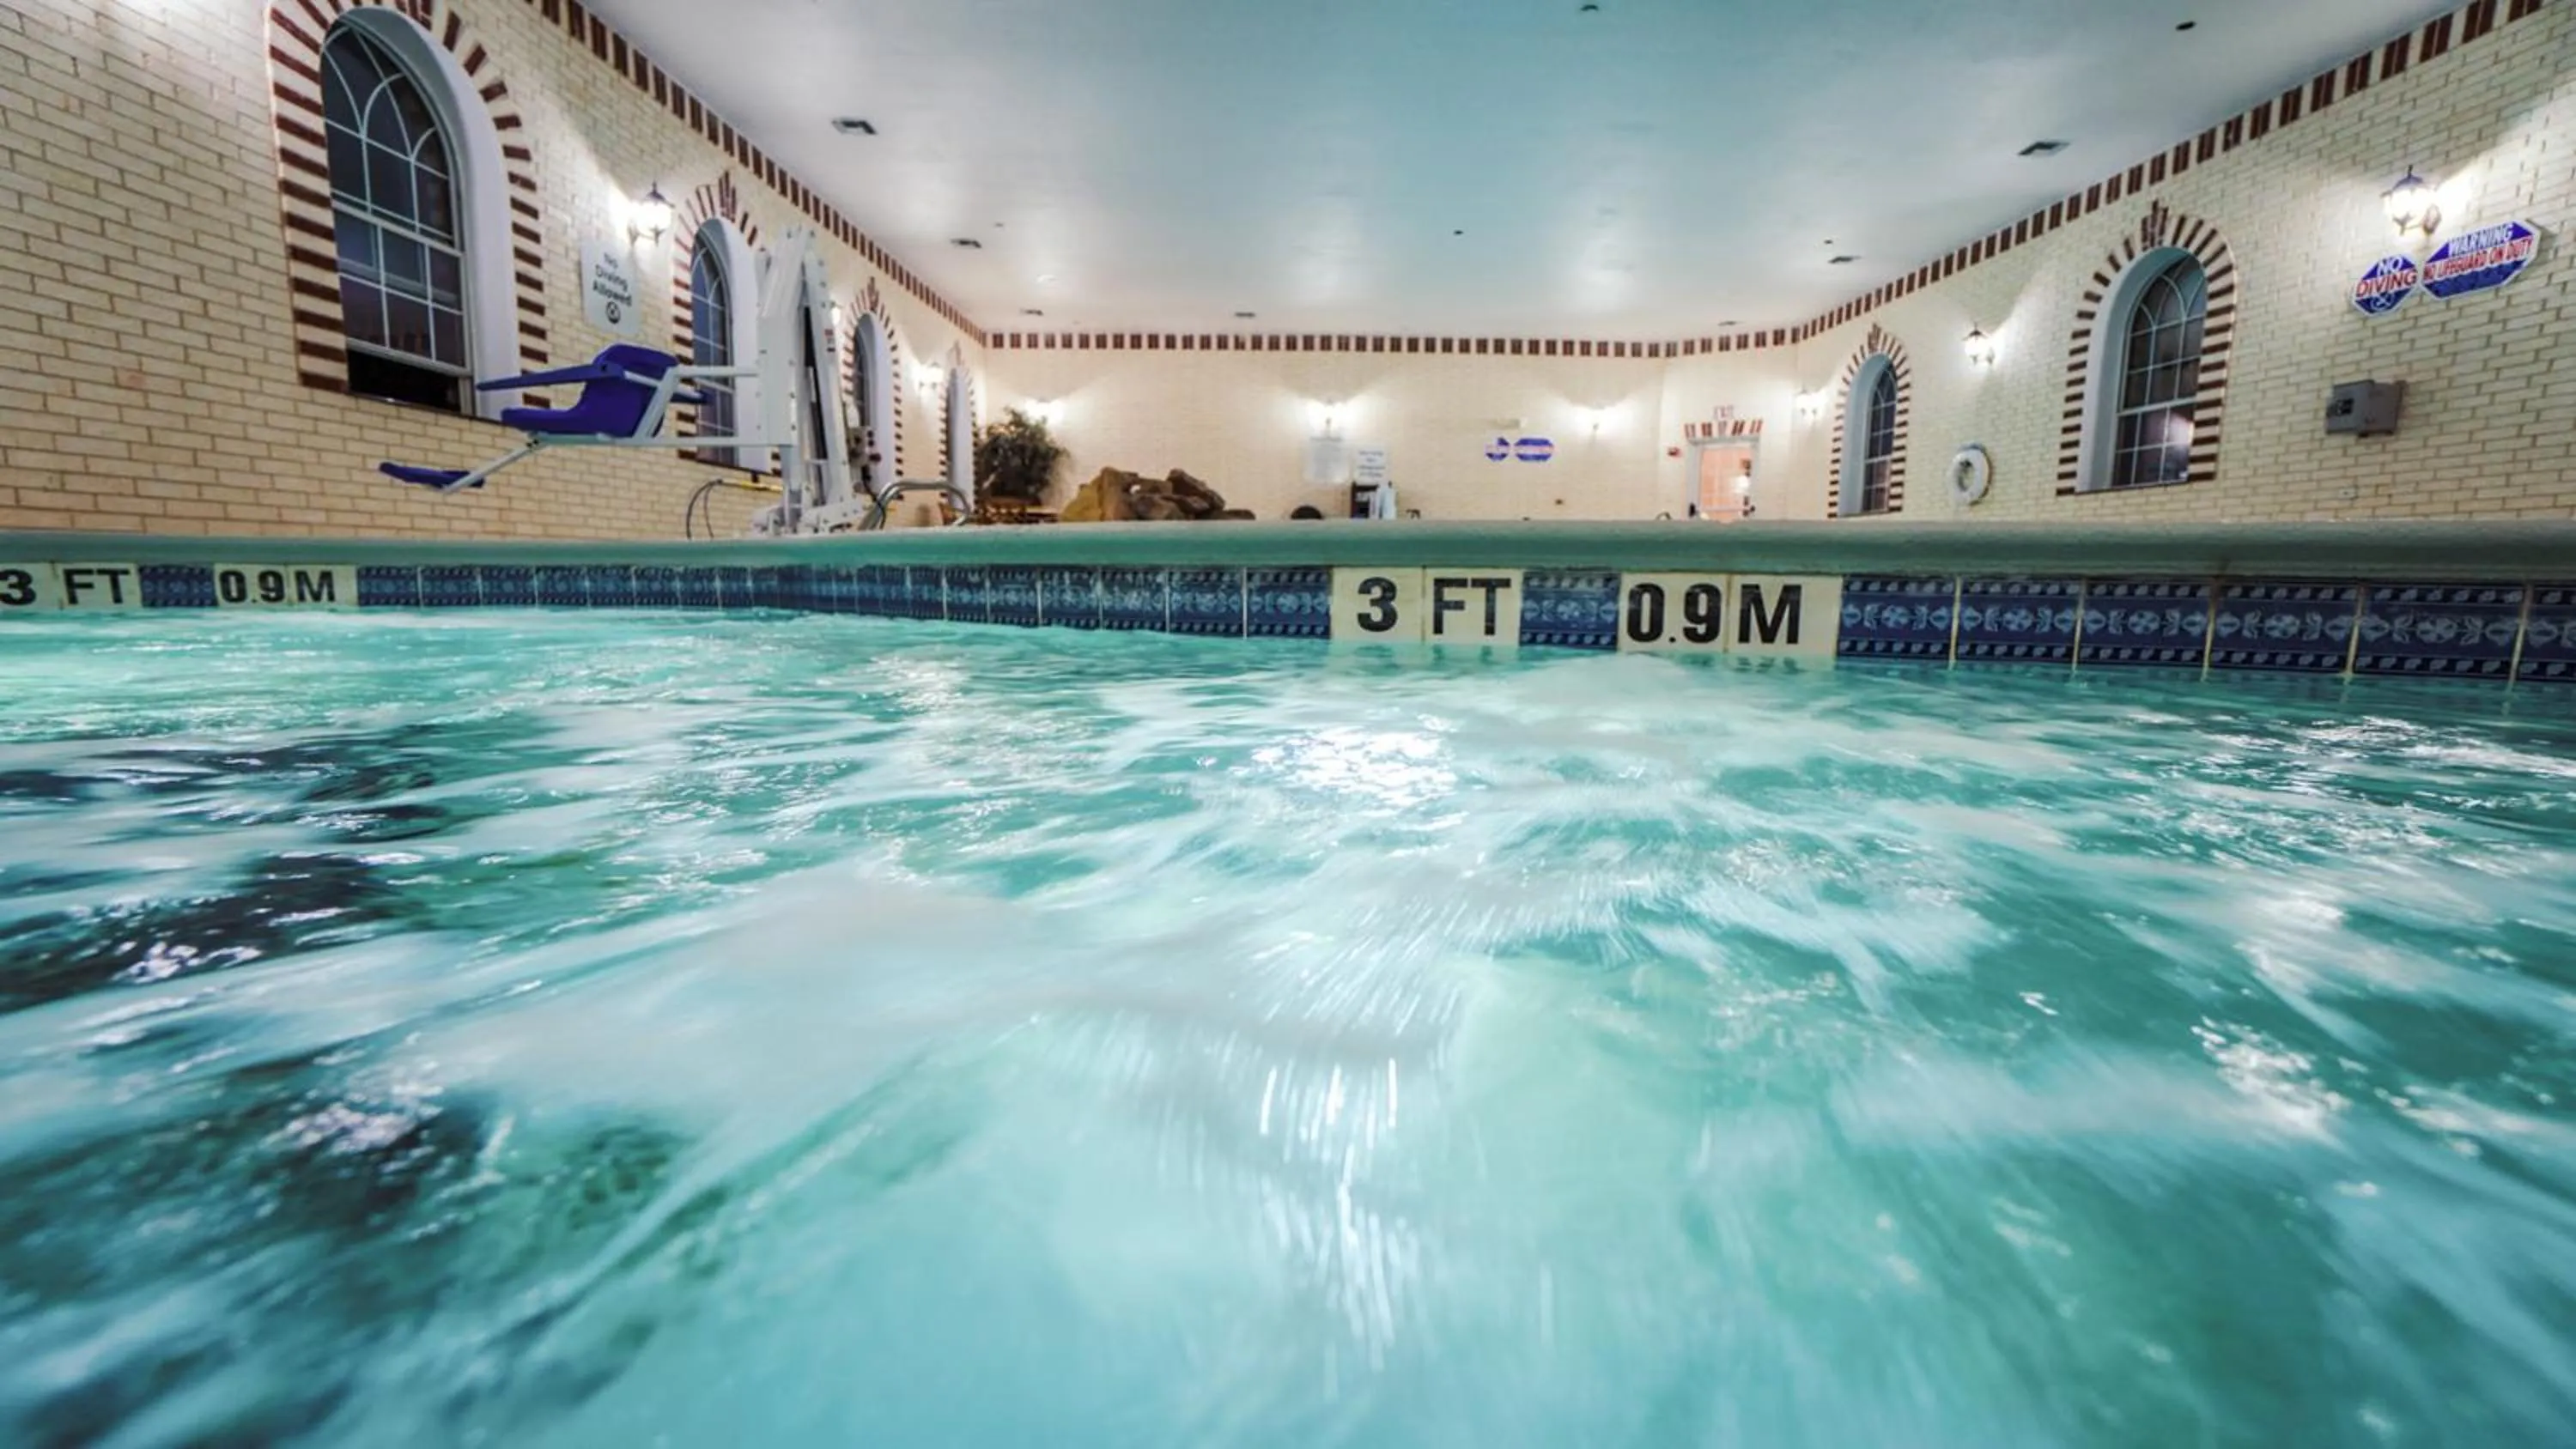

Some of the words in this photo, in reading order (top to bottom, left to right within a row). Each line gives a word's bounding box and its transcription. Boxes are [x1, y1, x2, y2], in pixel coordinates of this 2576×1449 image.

[594, 263, 629, 293] Diving
[2377, 257, 2403, 276] NO
[2356, 268, 2418, 298] DIVING
[0, 569, 37, 606] 3
[63, 568, 131, 605] FT
[1357, 576, 1398, 633] 3
[1432, 577, 1512, 635] FT
